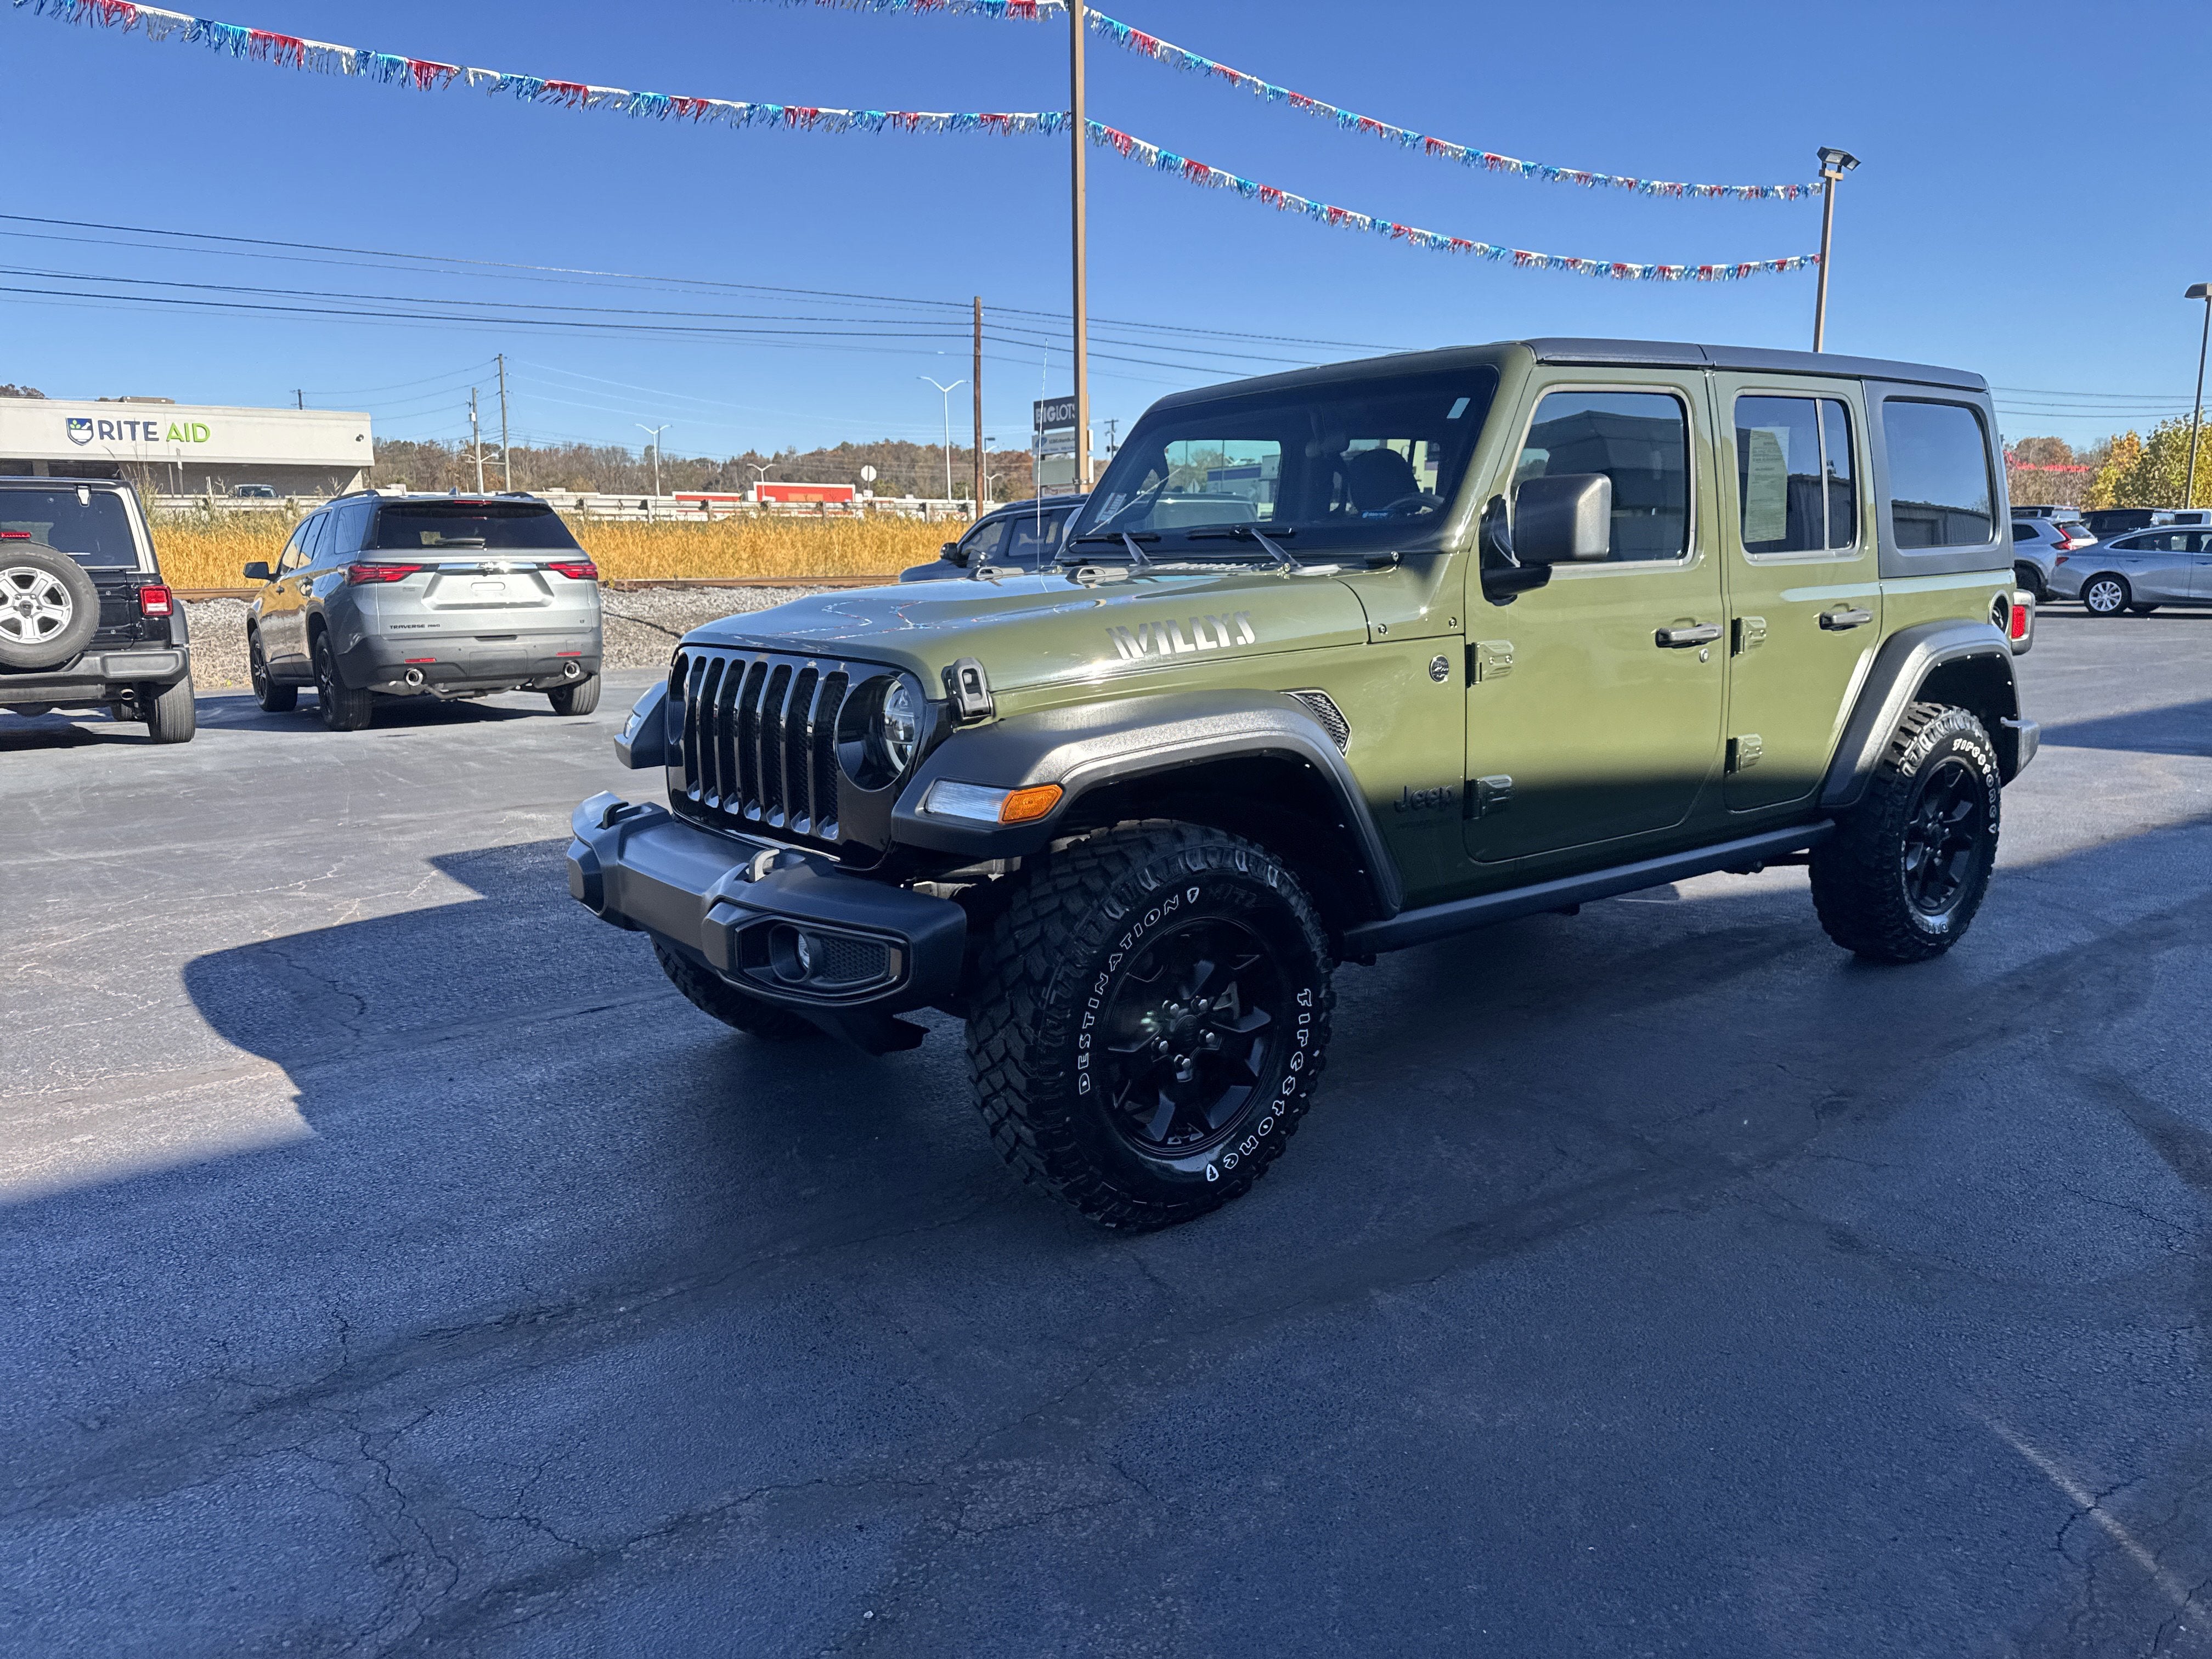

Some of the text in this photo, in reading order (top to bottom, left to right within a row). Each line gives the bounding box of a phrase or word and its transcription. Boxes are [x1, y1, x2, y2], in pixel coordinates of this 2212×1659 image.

[97, 420, 211, 443] RITE AID
[1105, 611, 1255, 660] WILLYS
[1393, 785, 1458, 812] Jeep
[1078, 895, 1179, 1095] DESTINATION
